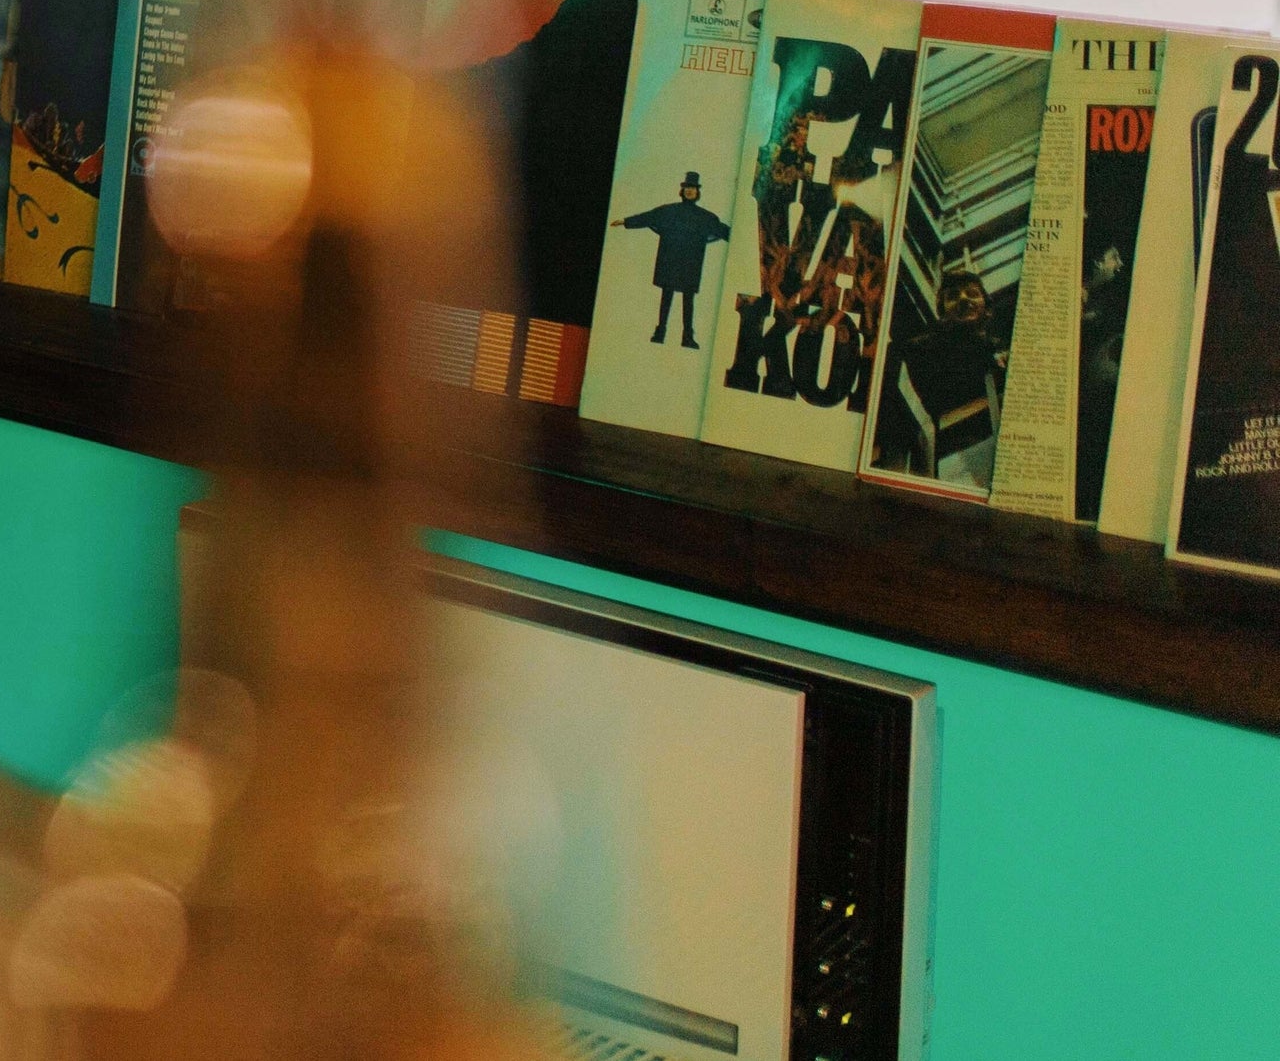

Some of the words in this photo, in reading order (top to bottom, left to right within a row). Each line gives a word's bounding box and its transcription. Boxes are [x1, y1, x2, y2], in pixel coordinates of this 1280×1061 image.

[690, 15, 741, 27] PARLOPHONE
[679, 43, 755, 77] HEL
[1223, 55, 1280, 171] 2
[724, 293, 875, 413] KO
[1195, 466, 1227, 478] ROCK
[1229, 464, 1252, 475] AND
